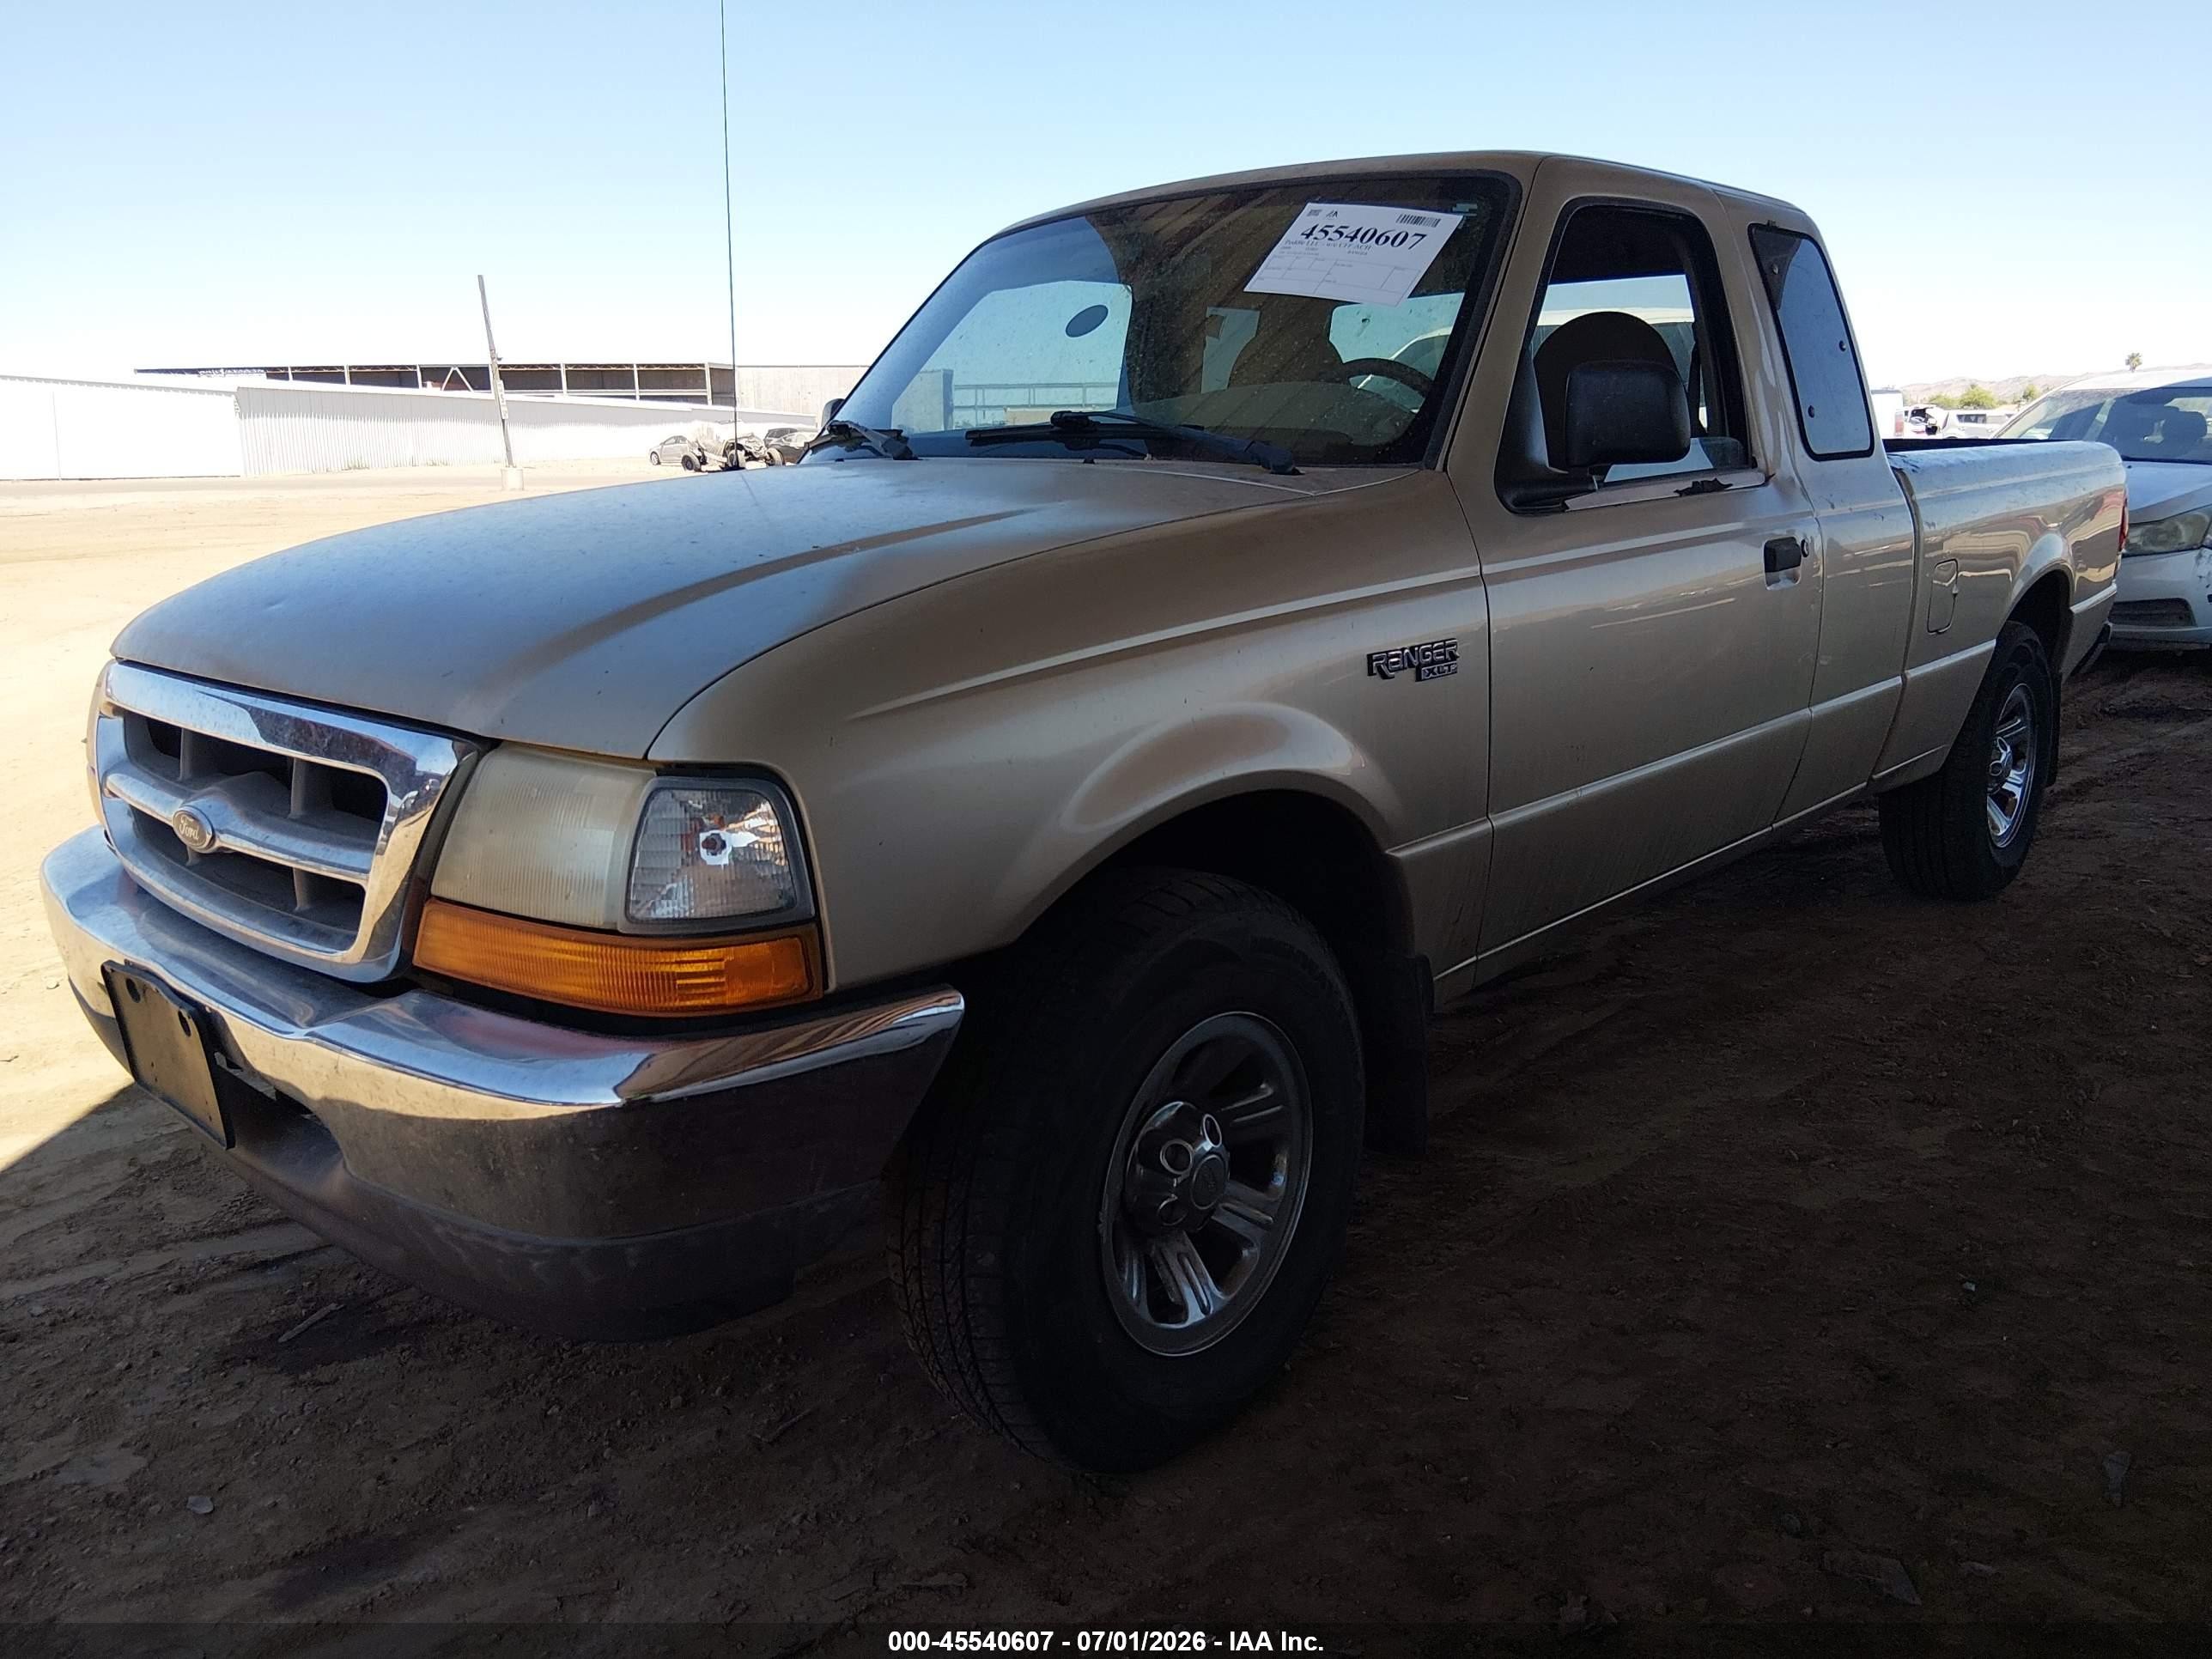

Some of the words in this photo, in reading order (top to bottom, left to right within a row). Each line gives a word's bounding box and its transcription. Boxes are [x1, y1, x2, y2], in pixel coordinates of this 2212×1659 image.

[1300, 223, 1428, 250] 45540607
[1366, 638, 1460, 679] RANGER
[1417, 660, 1458, 682] XLT
[179, 814, 200, 841] Ford
